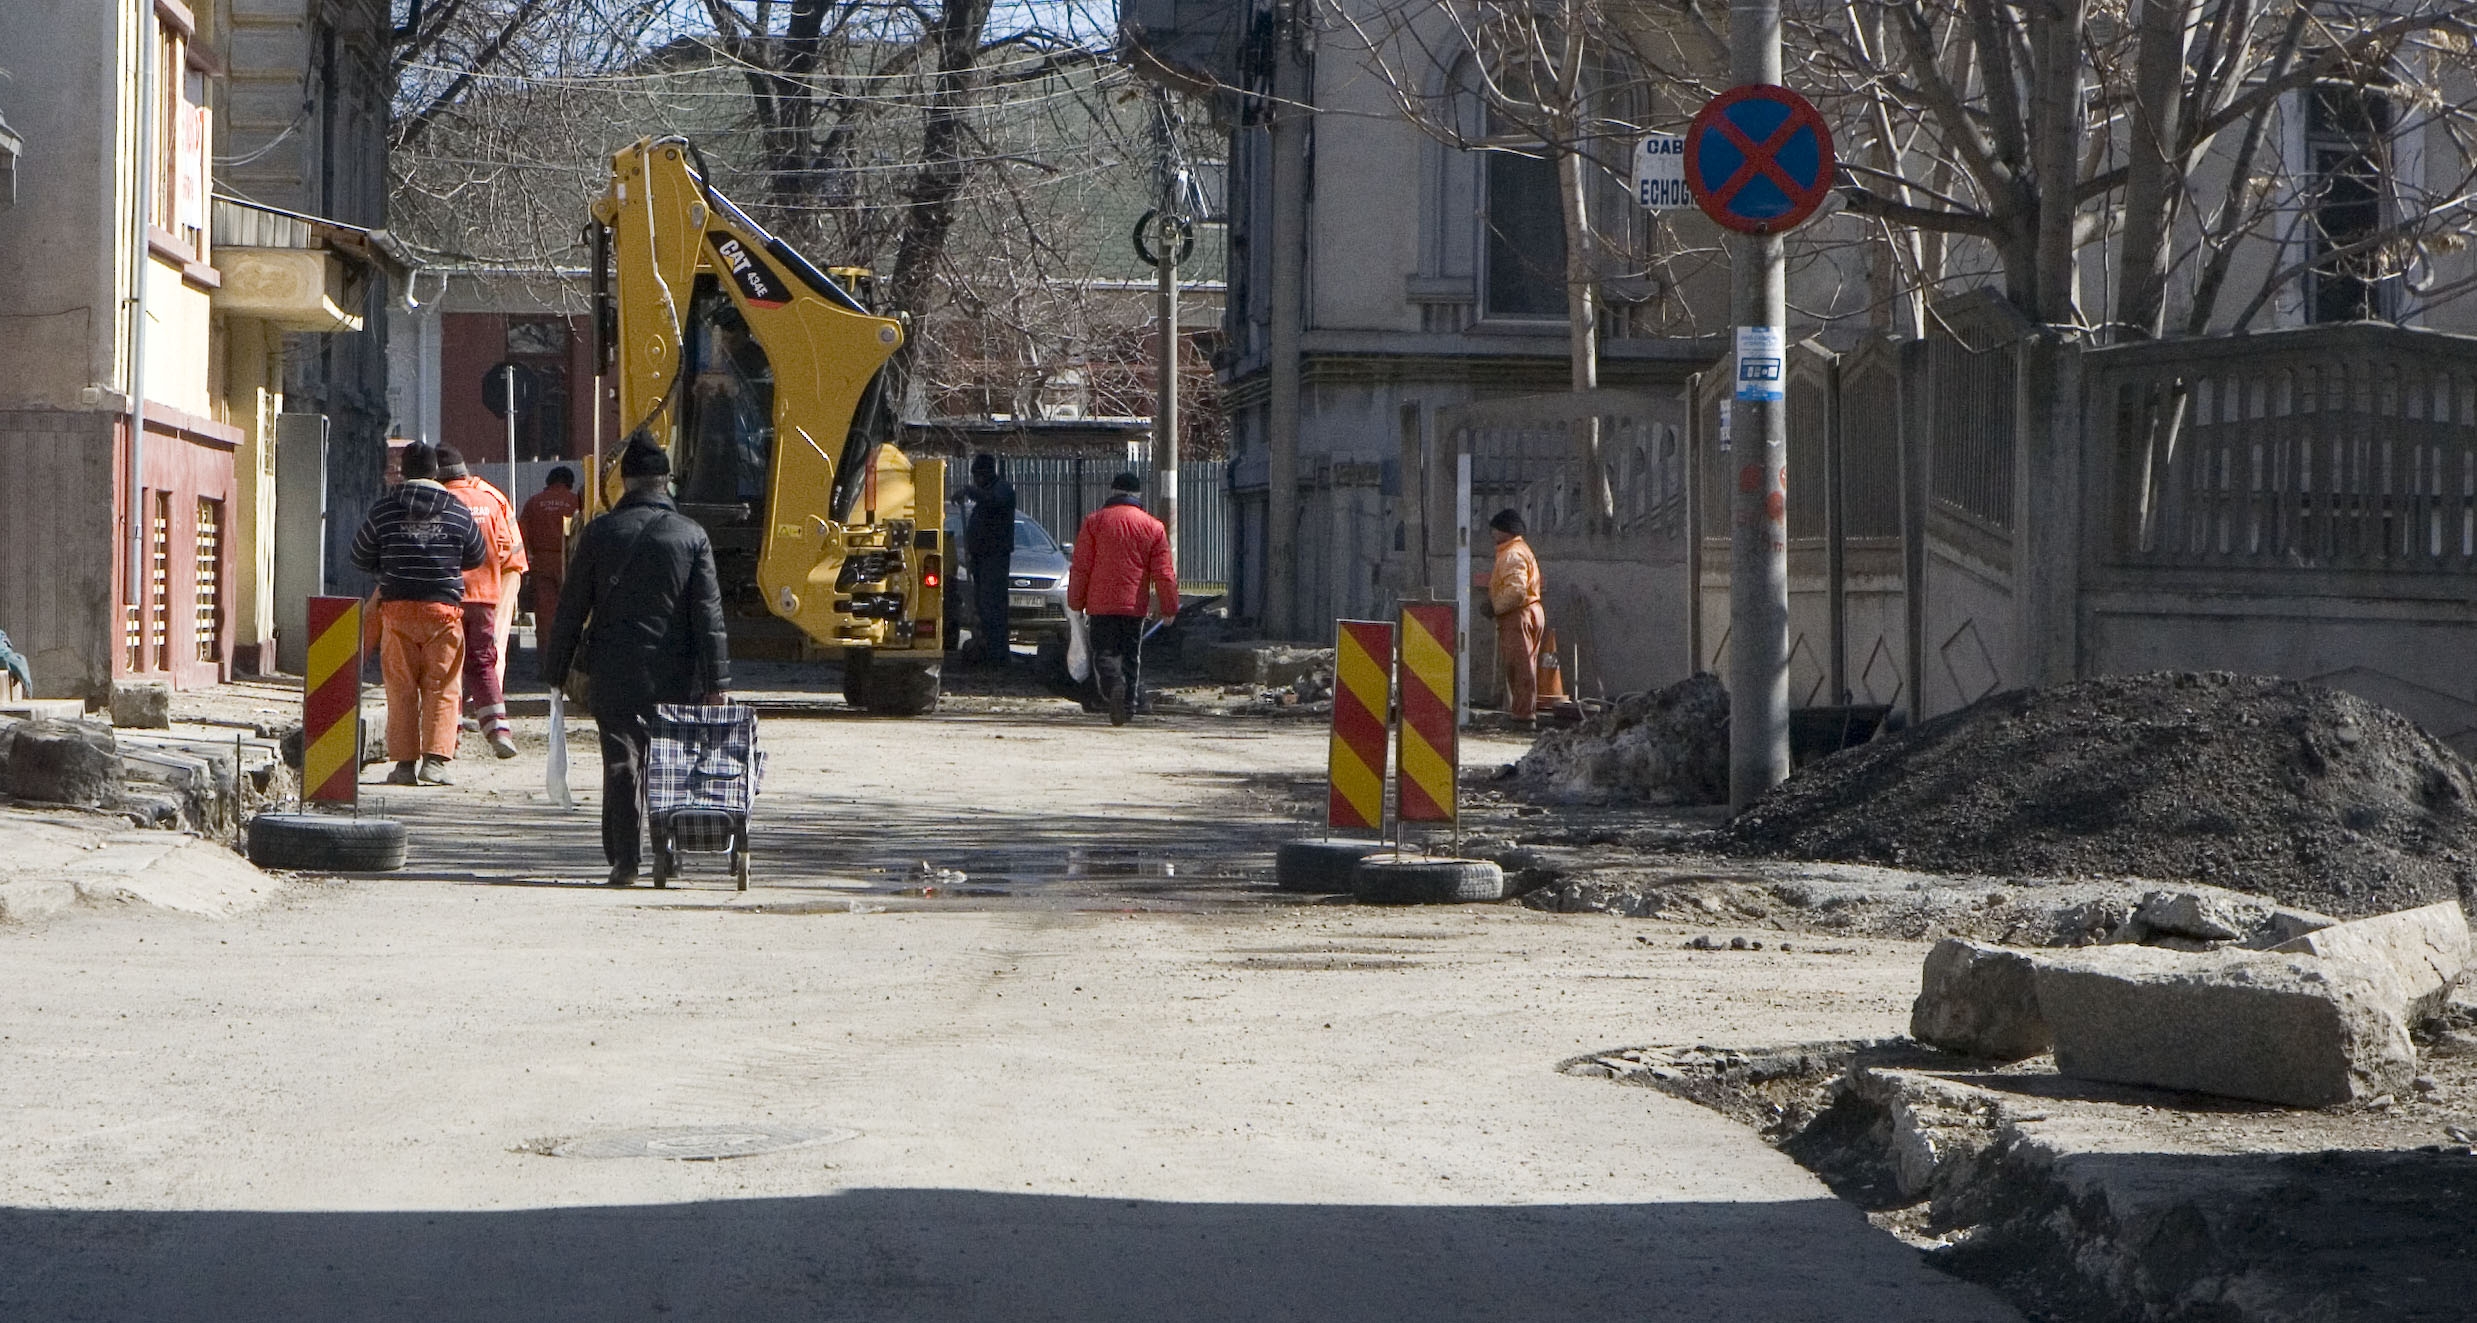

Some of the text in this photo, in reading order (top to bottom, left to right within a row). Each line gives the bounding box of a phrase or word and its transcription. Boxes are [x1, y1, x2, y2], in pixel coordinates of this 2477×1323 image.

[1640, 179, 1695, 206] ECHOG
[719, 239, 768, 298] CAT 434E
